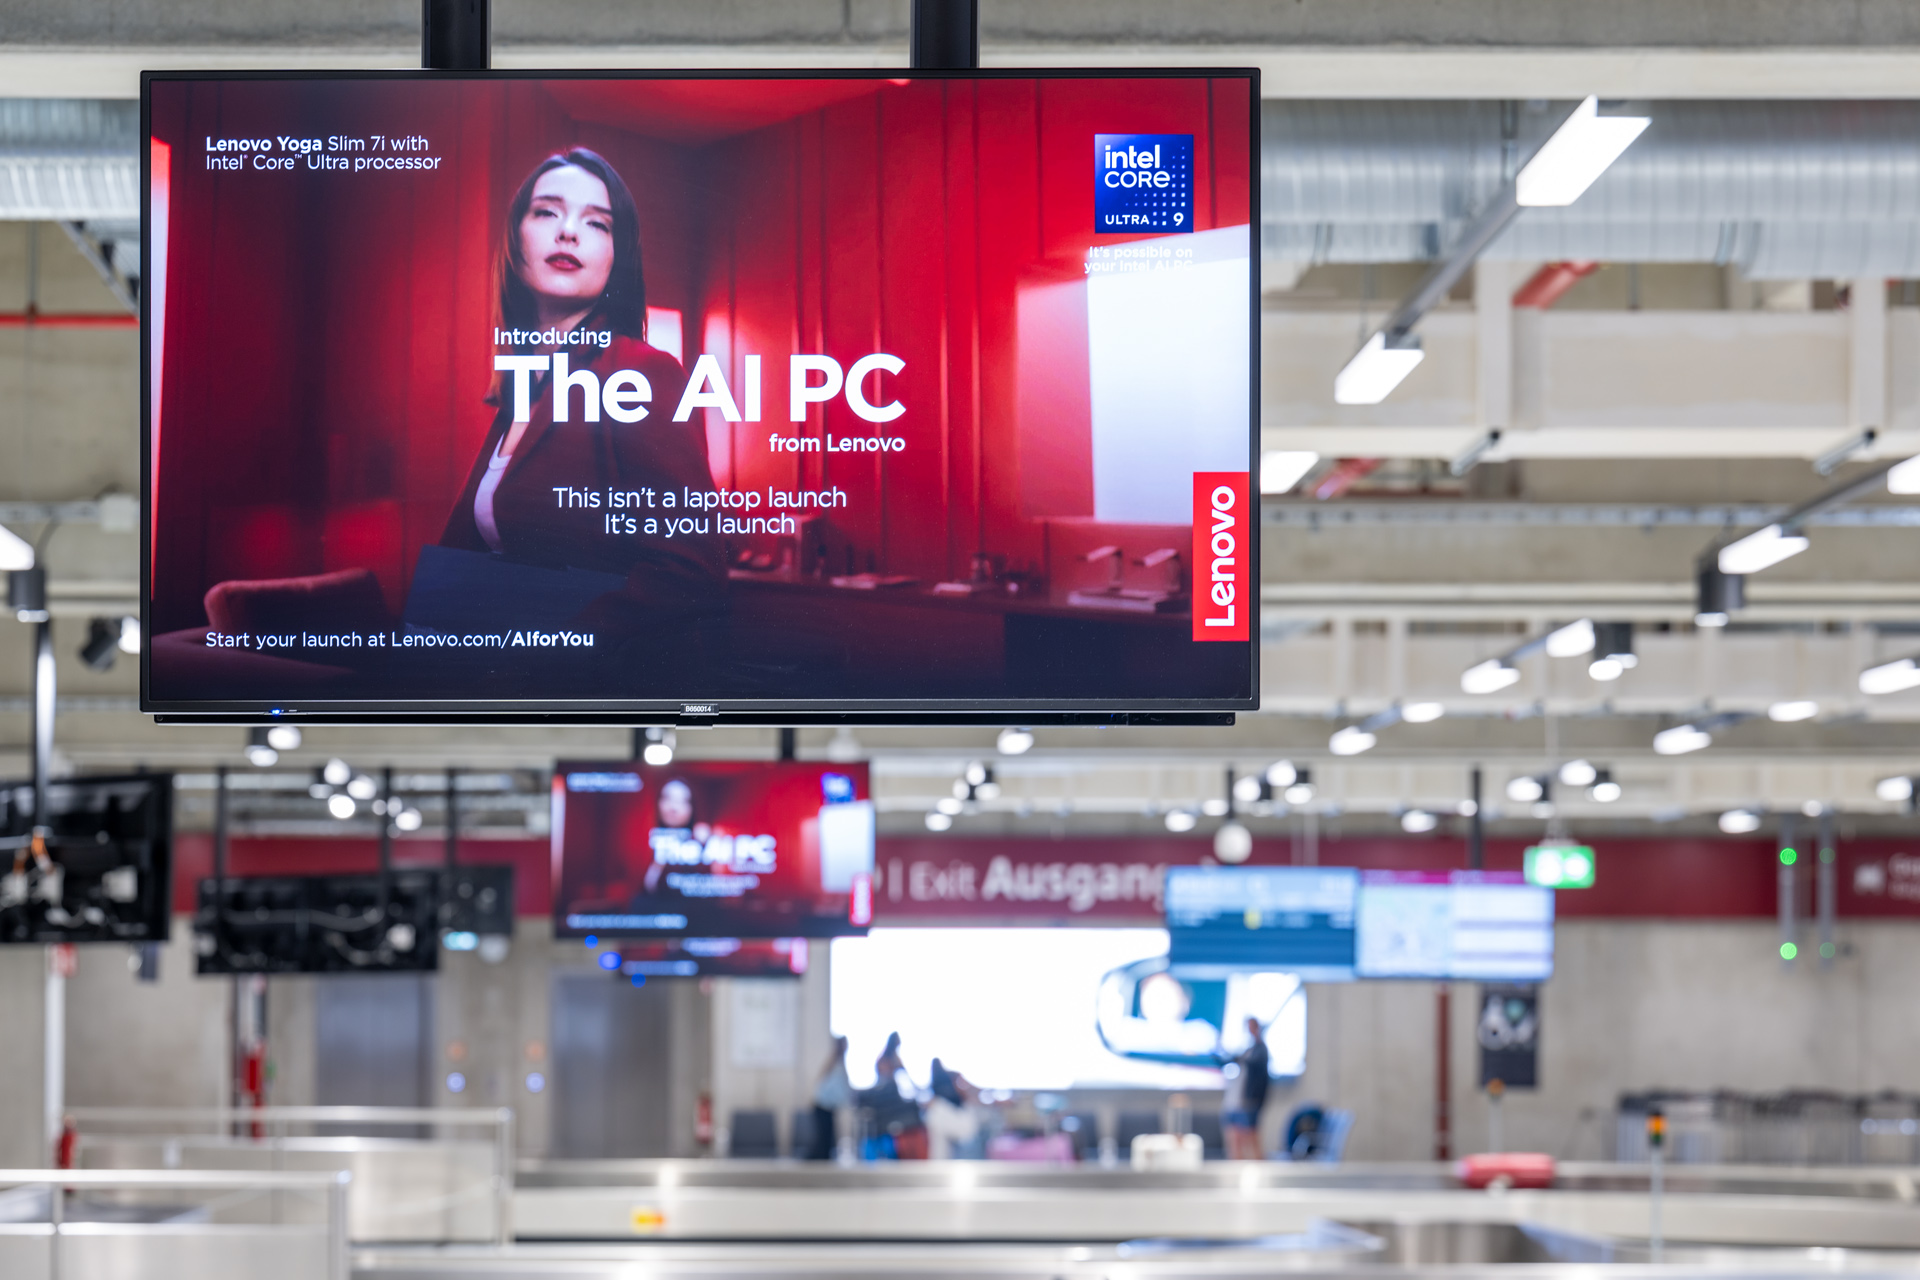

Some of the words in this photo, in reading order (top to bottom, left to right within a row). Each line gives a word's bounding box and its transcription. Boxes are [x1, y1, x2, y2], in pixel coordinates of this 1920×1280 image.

[206, 136, 272, 151] Lenovo
[277, 136, 323, 153] Yoga
[328, 135, 365, 151] Slim
[370, 135, 385, 151] 7i
[391, 135, 428, 151] with
[307, 154, 349, 170] Ultra
[355, 157, 441, 173] processor
[1105, 144, 1160, 169] intel
[1105, 214, 1150, 225] ULTRA
[1173, 212, 1184, 226] 9
[1114, 246, 1171, 260] possible
[1176, 248, 1192, 258] on
[1084, 262, 1115, 274] your
[1120, 260, 1150, 272] Intel
[1154, 260, 1169, 271] AI
[1174, 260, 1193, 271] PC
[494, 328, 611, 347] Introducing
[494, 353, 652, 423] The
[672, 354, 761, 422] AI
[790, 353, 907, 423] PC
[769, 434, 821, 452] from
[827, 434, 906, 452] Lenovo
[553, 487, 600, 508] This
[662, 491, 676, 508] a
[684, 487, 761, 511] laptop
[768, 486, 847, 508] launch
[644, 518, 657, 534] a
[665, 518, 709, 538] you
[717, 513, 795, 534] launch
[1205, 486, 1235, 626] Lenovo
[206, 632, 249, 647] Start
[256, 635, 296, 650] your
[302, 631, 362, 647] launch
[368, 633, 386, 647] at
[392, 630, 594, 649] Lenovo.com/AIforYou
[909, 861, 978, 900] Exit
